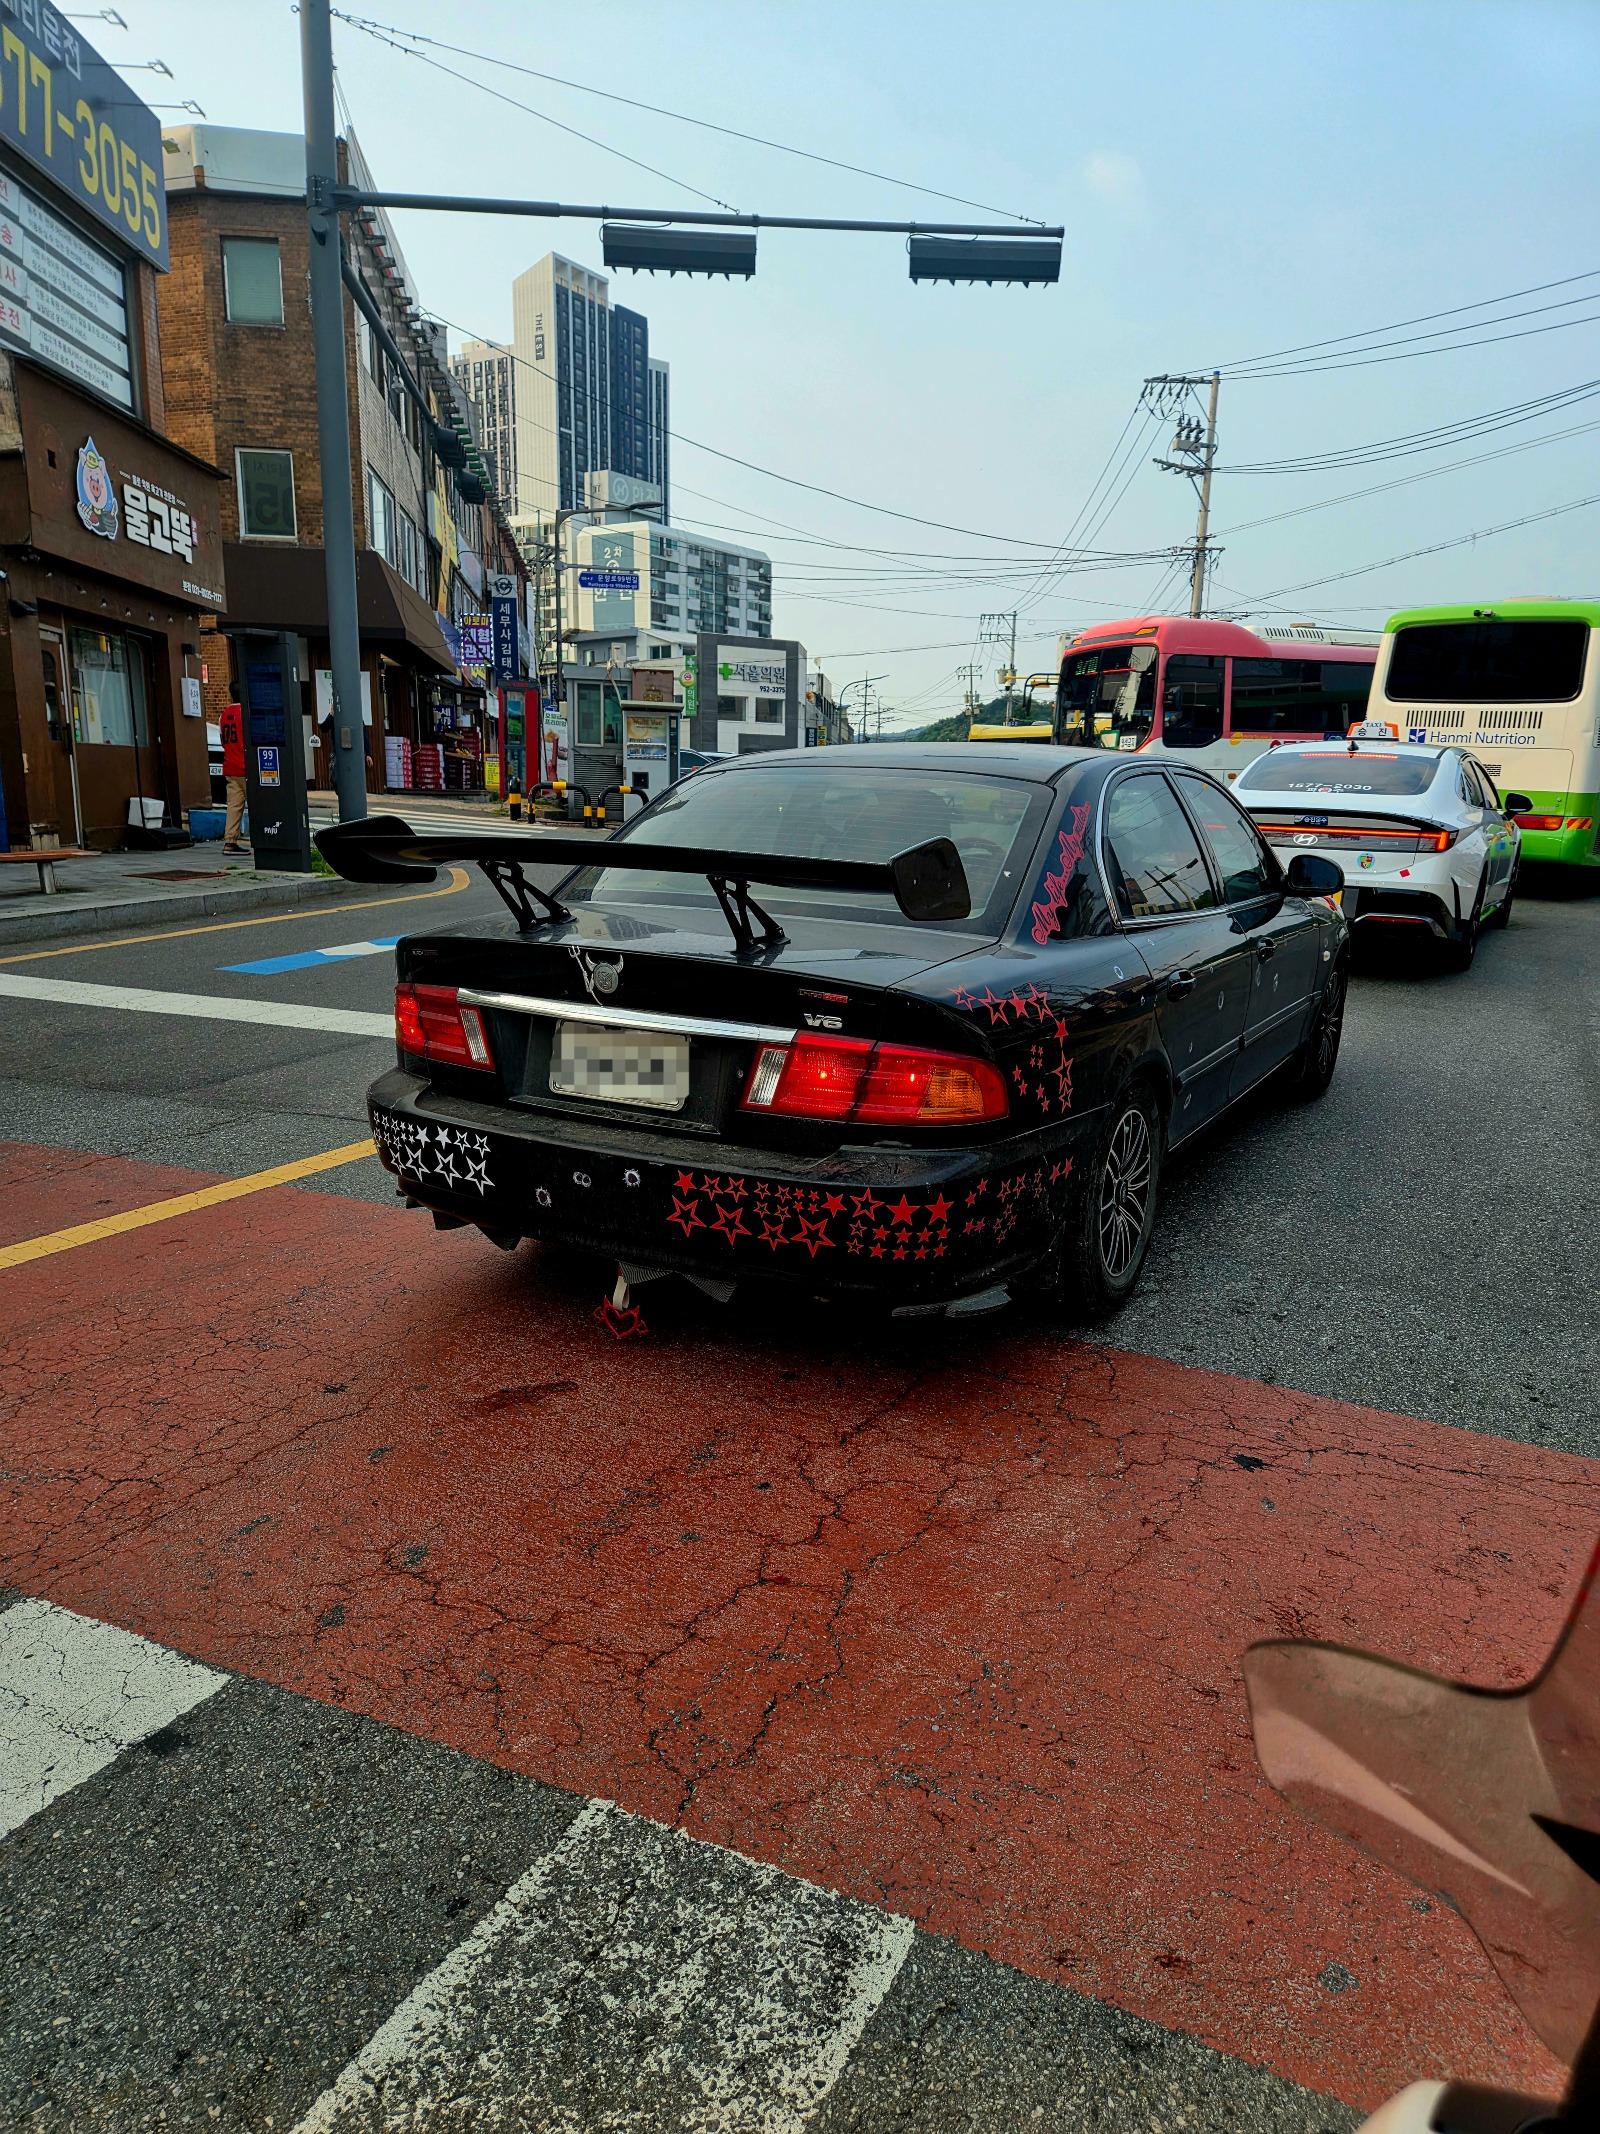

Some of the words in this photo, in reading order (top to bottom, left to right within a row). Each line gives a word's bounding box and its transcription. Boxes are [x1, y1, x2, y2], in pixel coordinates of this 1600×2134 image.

[0, 24, 161, 249] 77-3055
[535, 313, 543, 331] THE
[463, 616, 489, 626] 아로마
[735, 664, 786, 684] 서울의원
[1430, 731, 1472, 743] Hanmi
[1475, 732, 1536, 745] Nutrition
[262, 750, 273, 760] 99
[804, 1013, 843, 1029] V6
